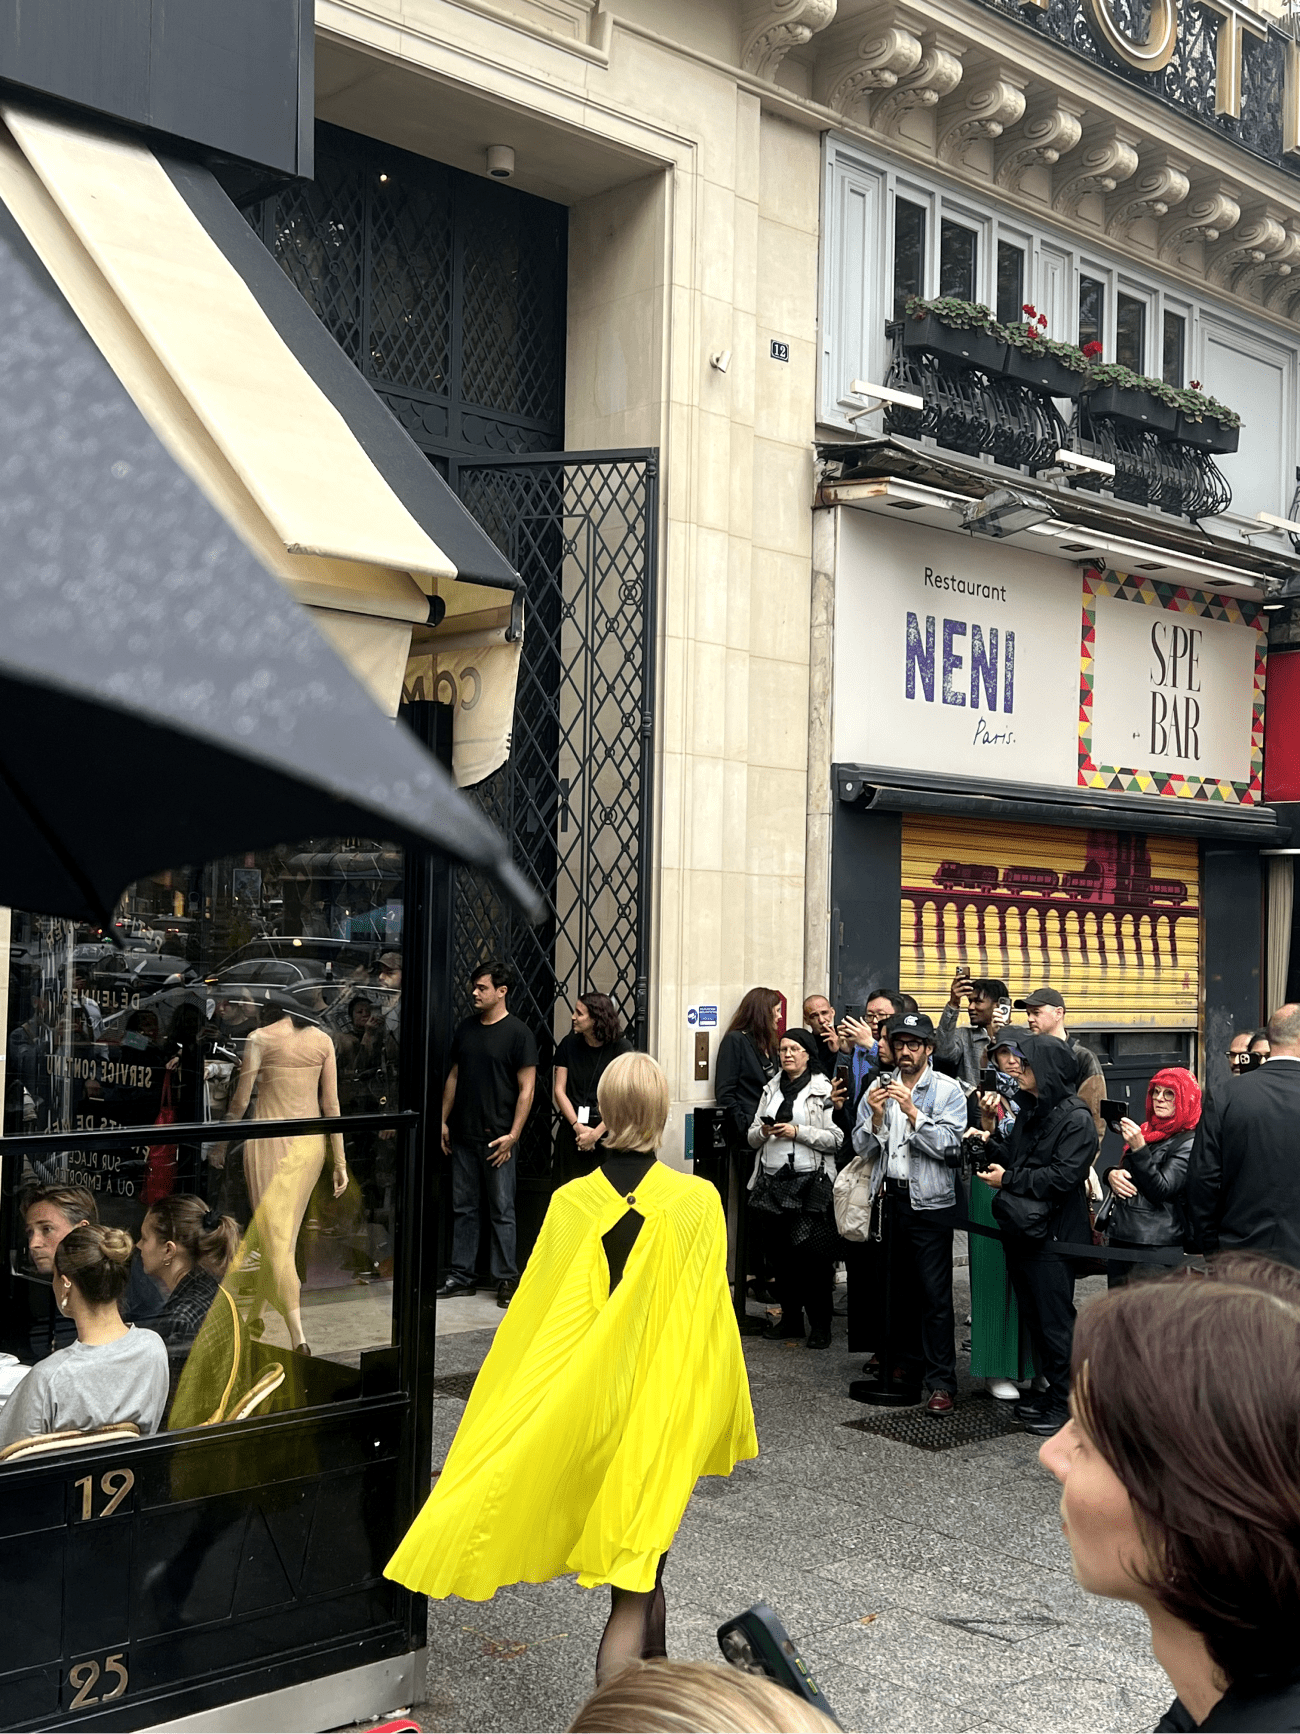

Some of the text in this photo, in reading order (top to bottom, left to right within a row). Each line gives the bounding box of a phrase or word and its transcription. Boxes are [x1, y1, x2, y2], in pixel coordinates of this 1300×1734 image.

[774, 344, 786, 358] 12
[924, 566, 1007, 602] Restaurant
[905, 611, 1016, 714] NENI
[1149, 690, 1201, 761] BAR
[74, 1467, 135, 1521] 19
[69, 1653, 129, 1710] 25
